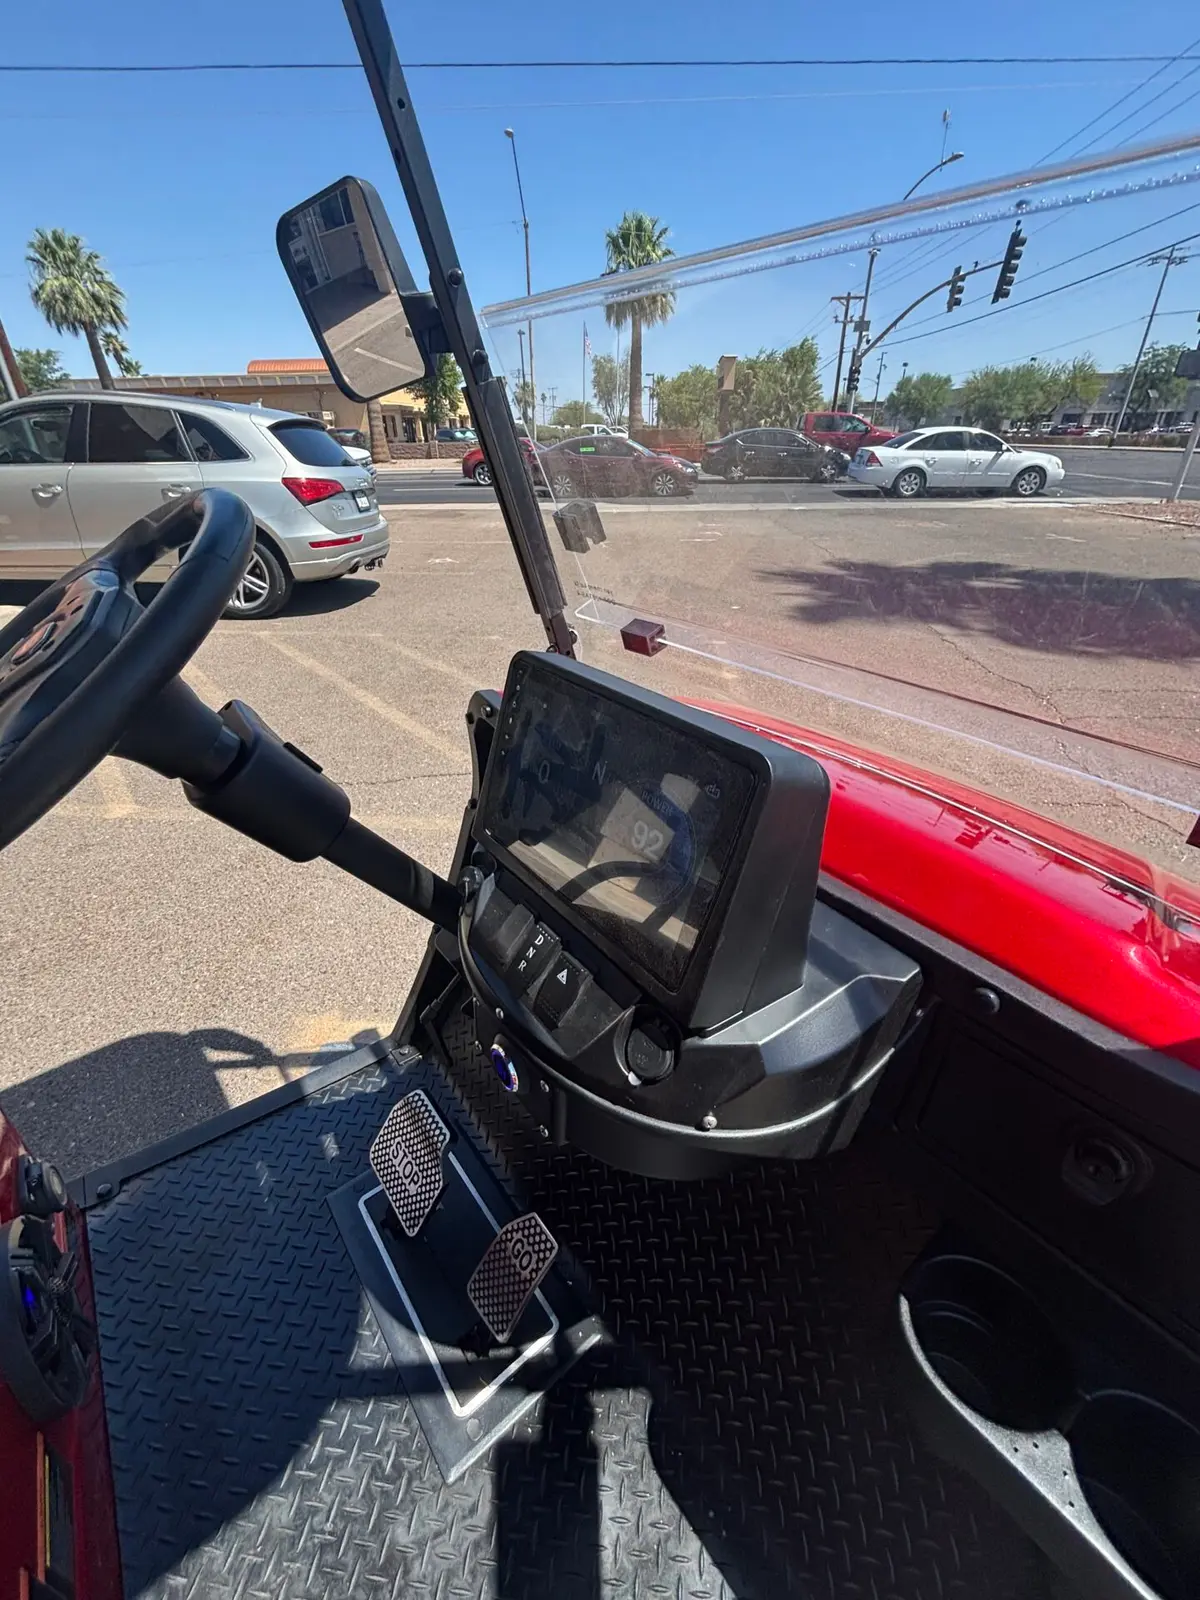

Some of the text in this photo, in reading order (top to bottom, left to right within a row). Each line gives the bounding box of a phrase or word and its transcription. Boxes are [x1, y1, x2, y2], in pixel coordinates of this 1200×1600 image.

[631, 820, 664, 861] 92
[534, 934, 545, 946] D
[526, 947, 537, 959] N
[518, 960, 528, 972] R
[392, 1141, 420, 1186] STOP
[511, 1238, 532, 1271] GO
